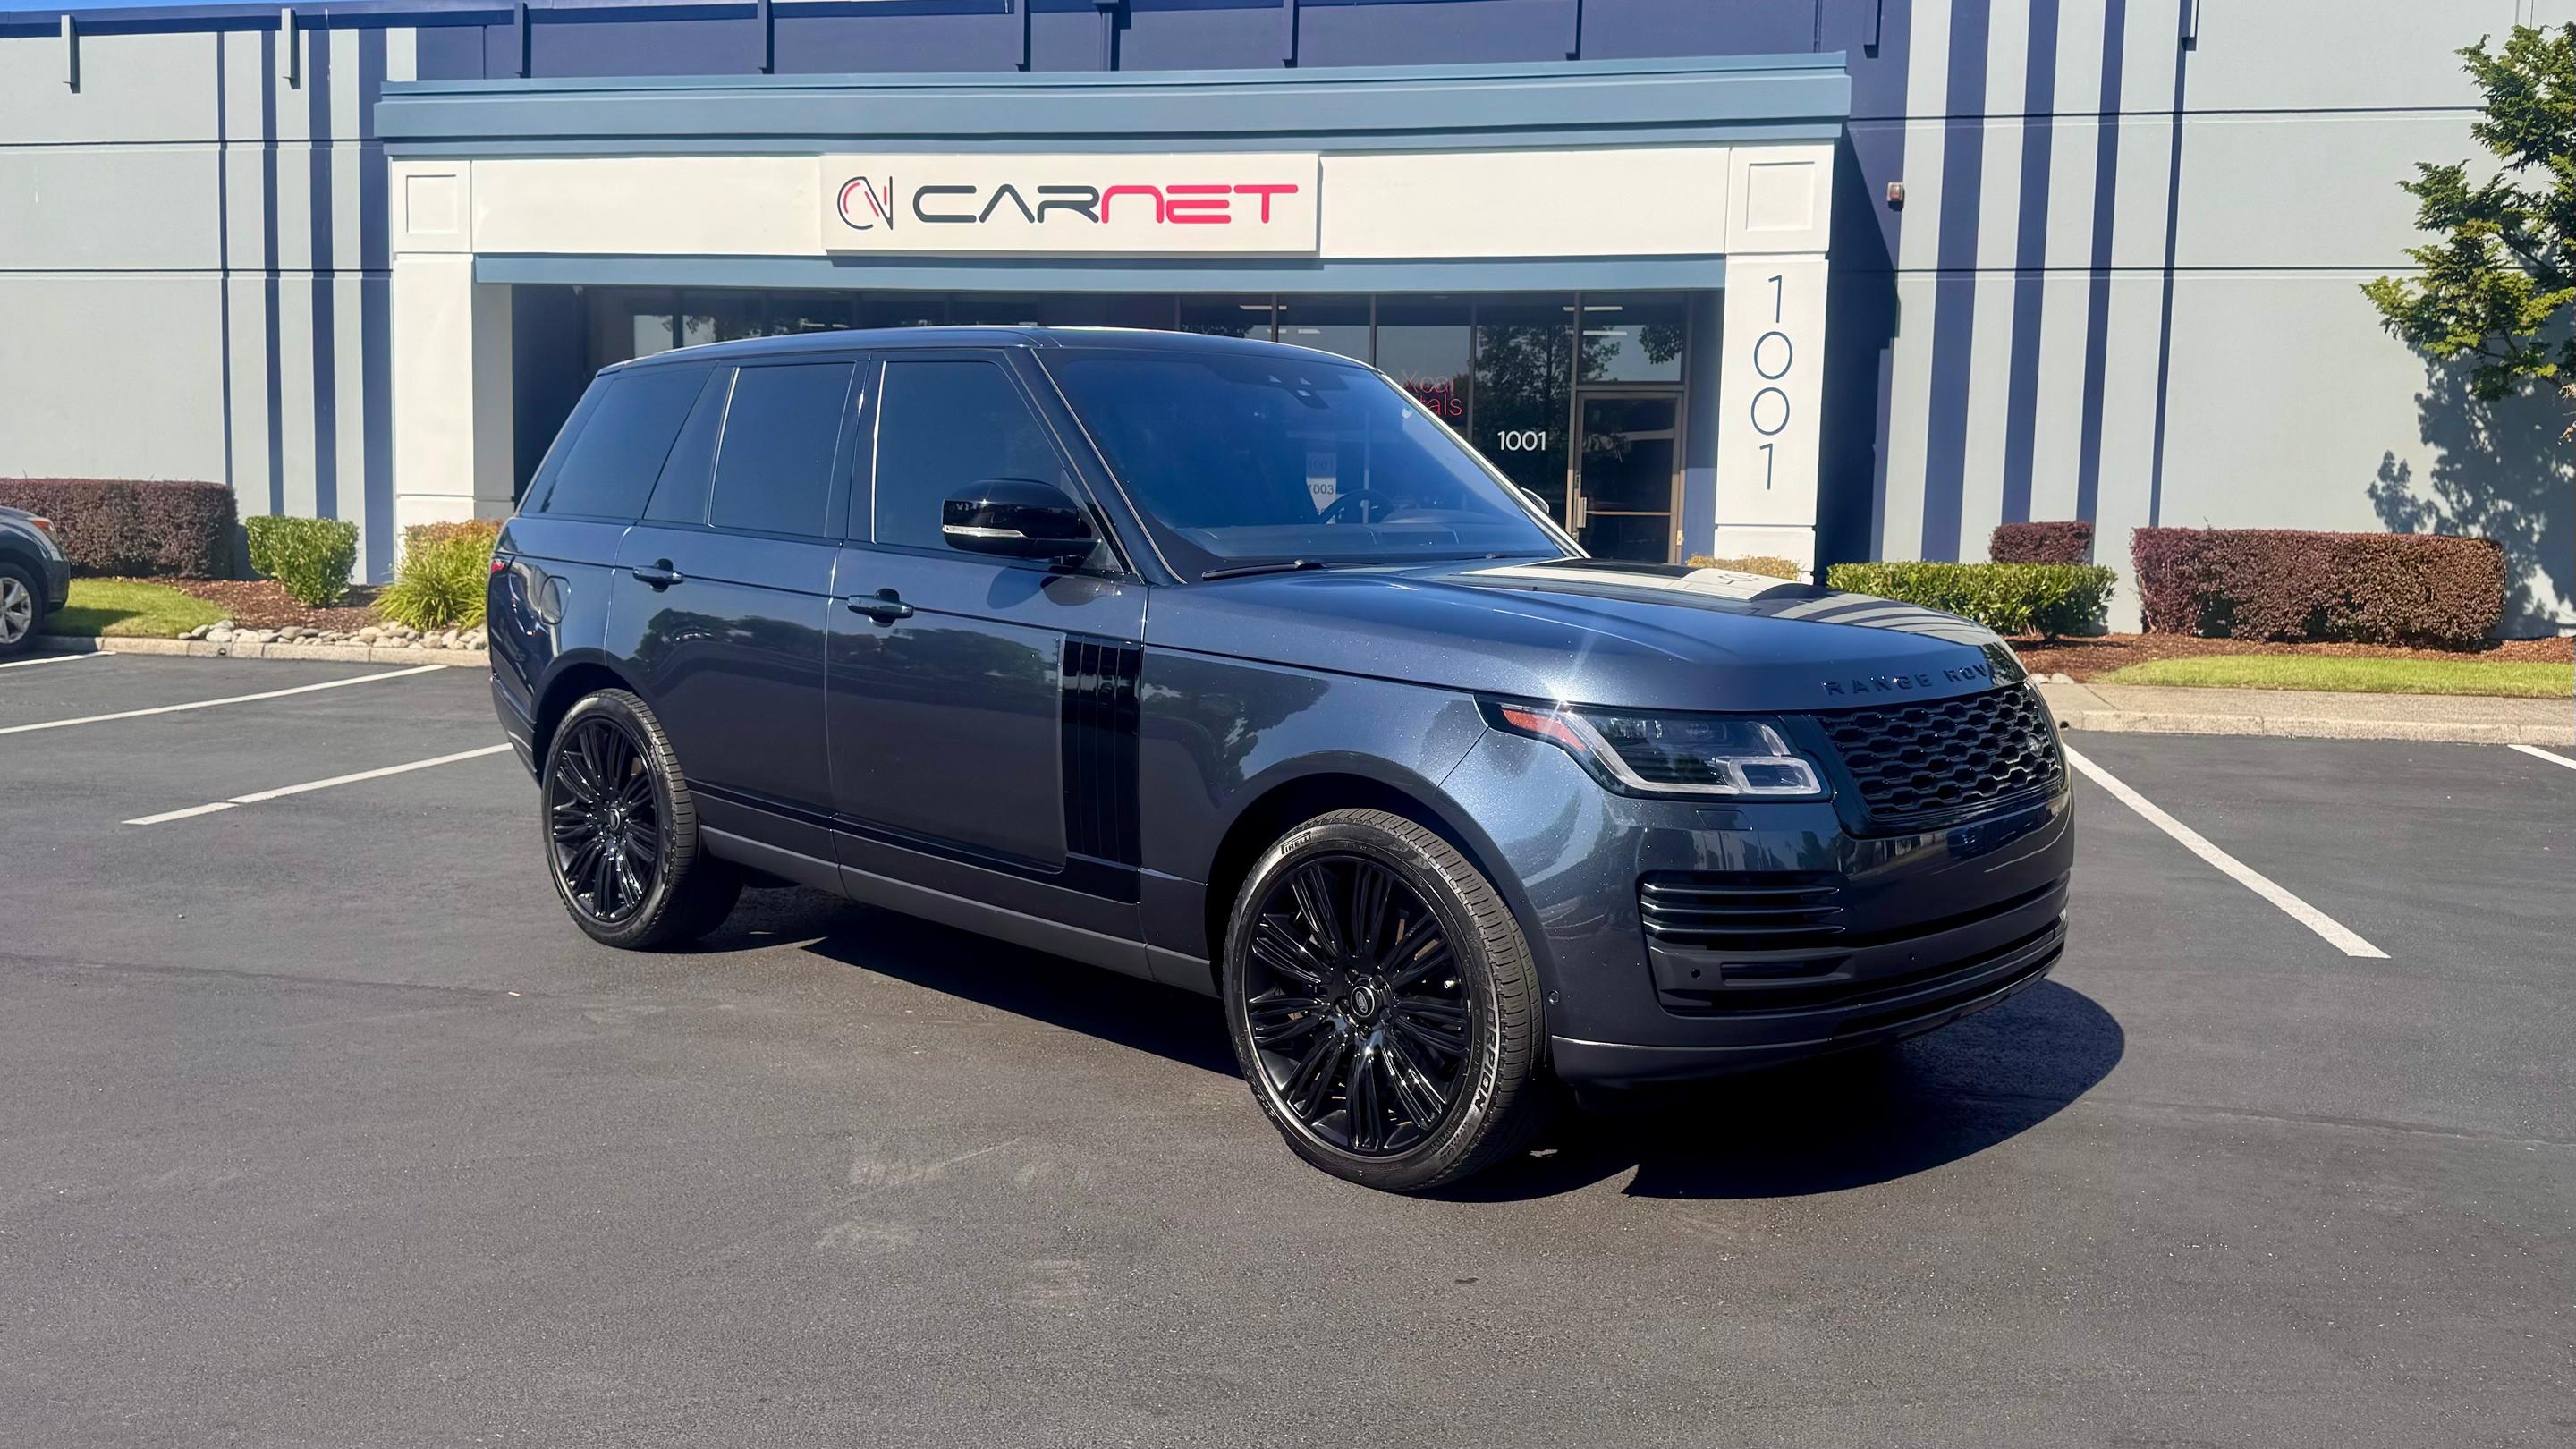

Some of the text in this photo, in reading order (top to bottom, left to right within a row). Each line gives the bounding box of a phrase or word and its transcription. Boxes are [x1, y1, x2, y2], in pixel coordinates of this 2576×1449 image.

[912, 183, 1299, 225] CARNET
[1750, 275, 1793, 491] 1001
[1497, 430, 1546, 451] 1001
[1821, 663, 1989, 696] RANGE ROV
[1281, 831, 1312, 855] PIRELLI
[1475, 970, 1497, 1113] SCORPION
